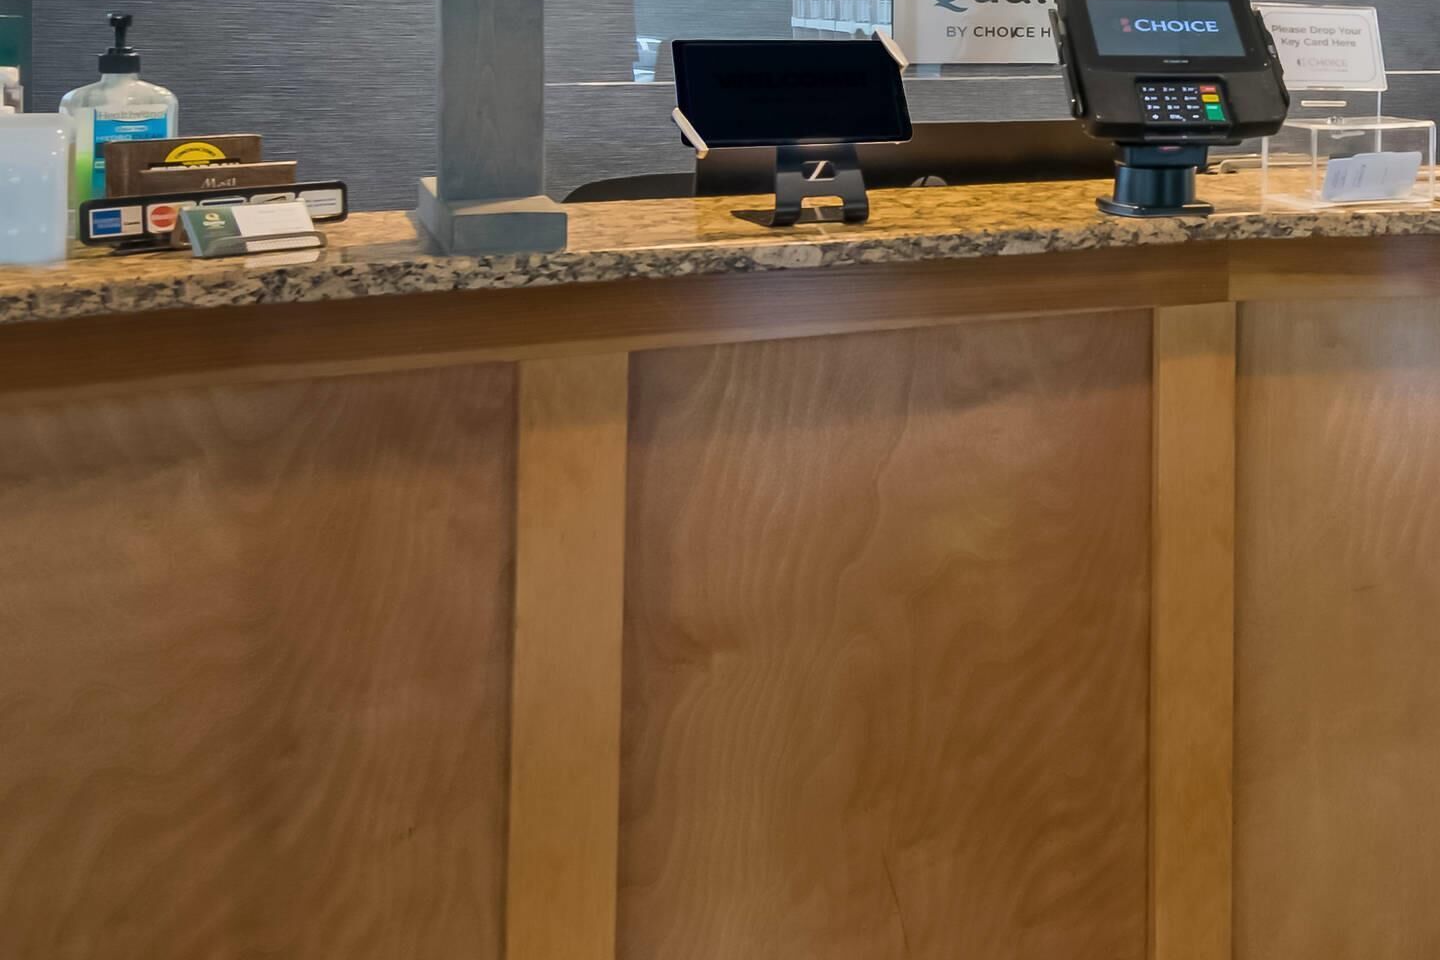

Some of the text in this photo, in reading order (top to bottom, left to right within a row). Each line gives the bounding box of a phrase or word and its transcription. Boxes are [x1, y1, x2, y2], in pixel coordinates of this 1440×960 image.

[1134, 19, 1219, 32] CHOICE
[1271, 25, 1361, 35] Please Drop Your
[946, 26, 967, 38] BY
[973, 26, 1035, 38] CHOICE
[1281, 38, 1356, 47] Key Card Here
[201, 177, 236, 189] Mail
